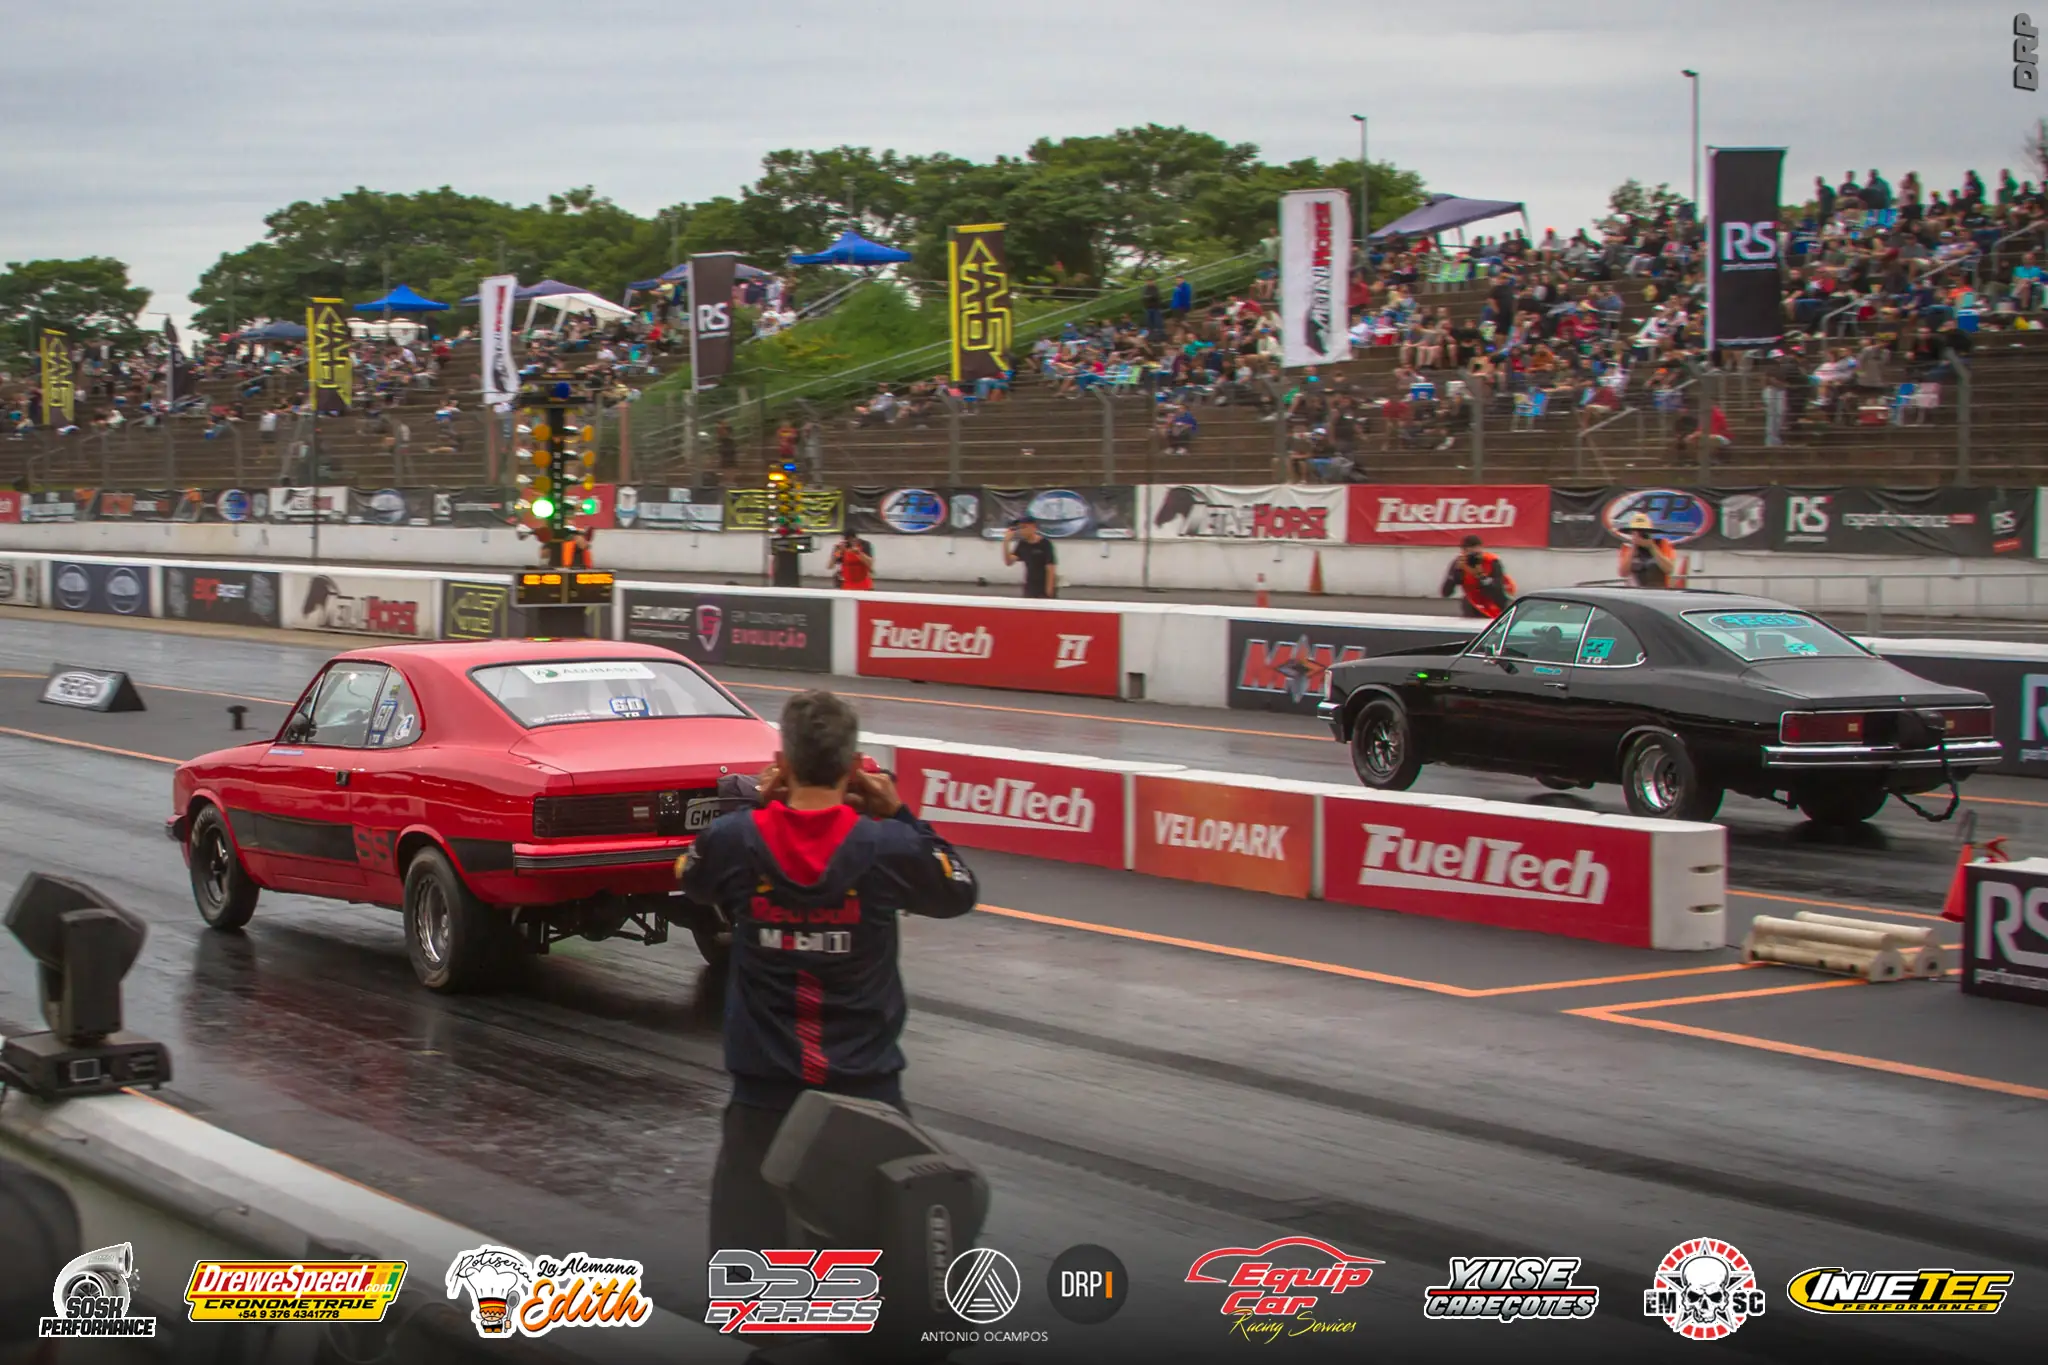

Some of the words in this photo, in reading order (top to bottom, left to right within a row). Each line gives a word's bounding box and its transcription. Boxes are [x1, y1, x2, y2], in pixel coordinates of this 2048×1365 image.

[1721, 221, 1778, 261] RS
[697, 302, 730, 332] RS
[1376, 497, 1518, 529] FuelTech
[1786, 496, 1831, 532] RS
[731, 625, 807, 649] EVOLUÇÃO
[870, 619, 994, 658] FuelTech
[920, 768, 1095, 833] FuelTech
[1153, 810, 1289, 861] VELOPARK
[1361, 823, 1610, 905] FuelTech
